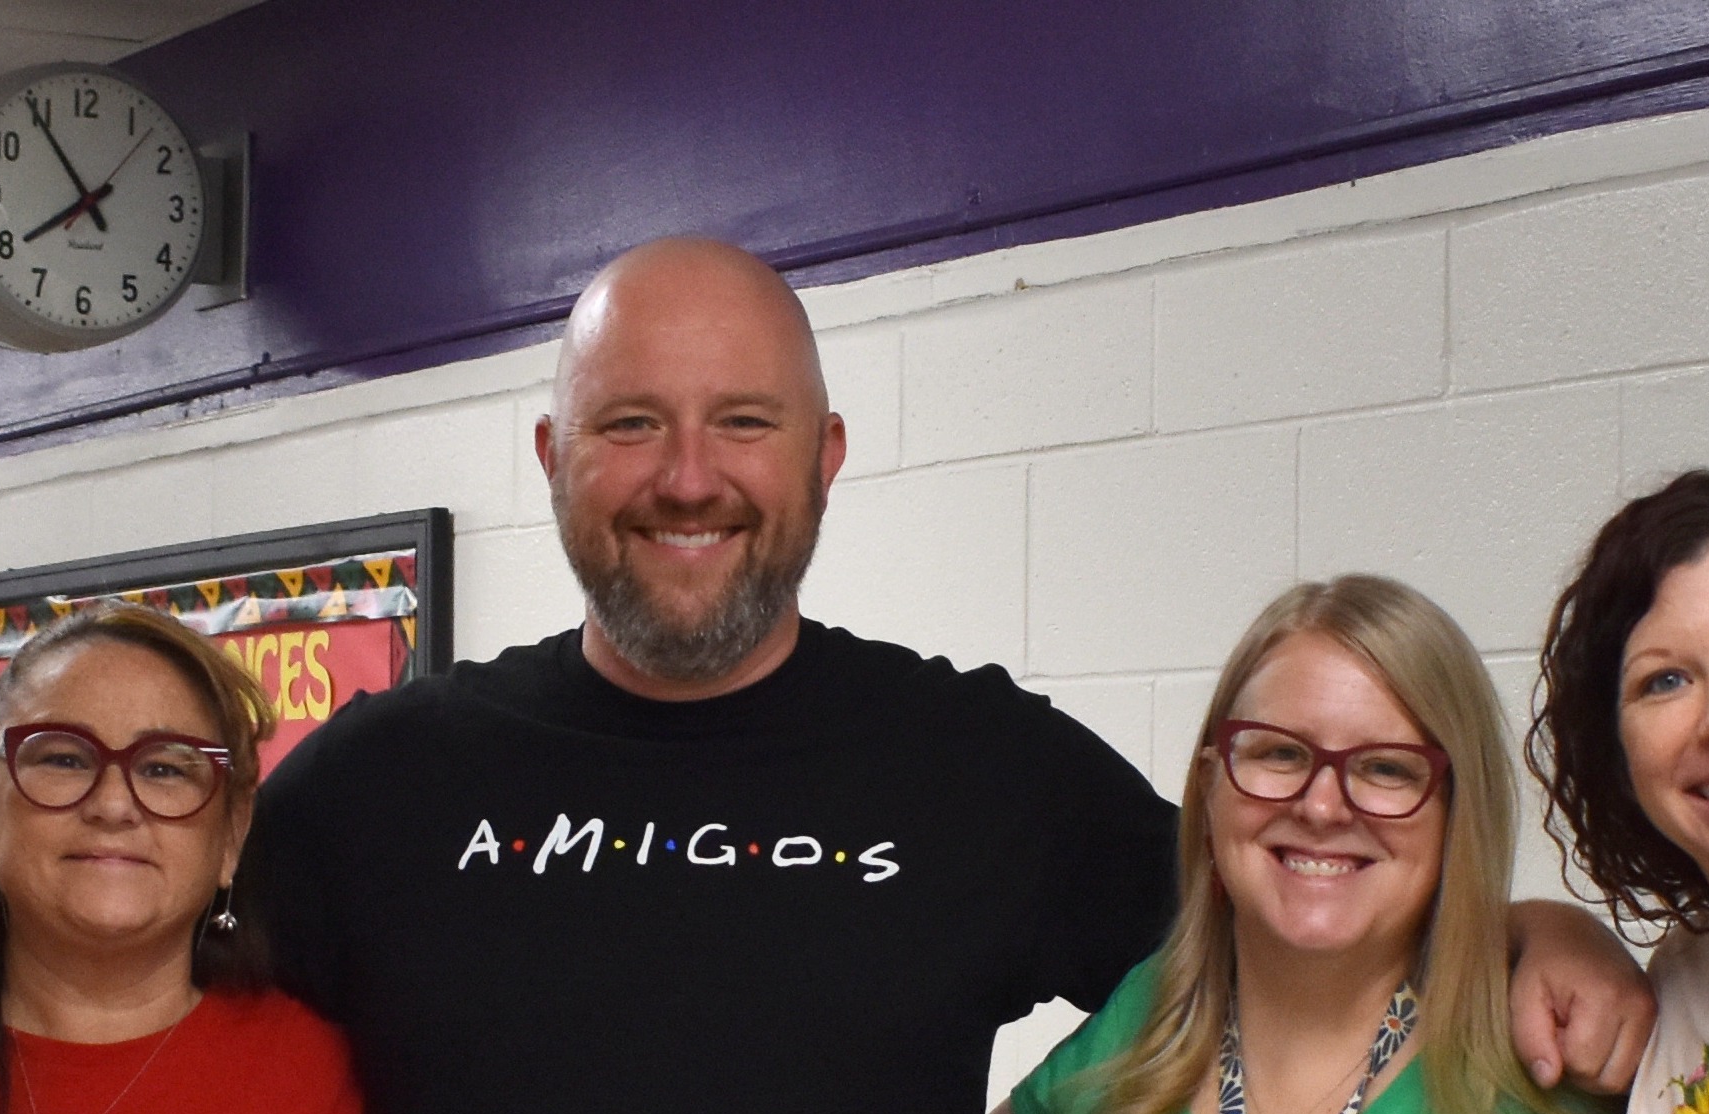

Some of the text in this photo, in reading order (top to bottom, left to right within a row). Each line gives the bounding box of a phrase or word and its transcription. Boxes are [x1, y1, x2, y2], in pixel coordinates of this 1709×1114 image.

[74, 88, 99, 119] 12
[128, 106, 136, 136] 1
[157, 146, 172, 175] 2
[170, 195, 185, 223] 3
[156, 243, 173, 273] 4
[32, 267, 48, 298] 7
[123, 275, 138, 303] 5
[76, 286, 91, 315] 6
